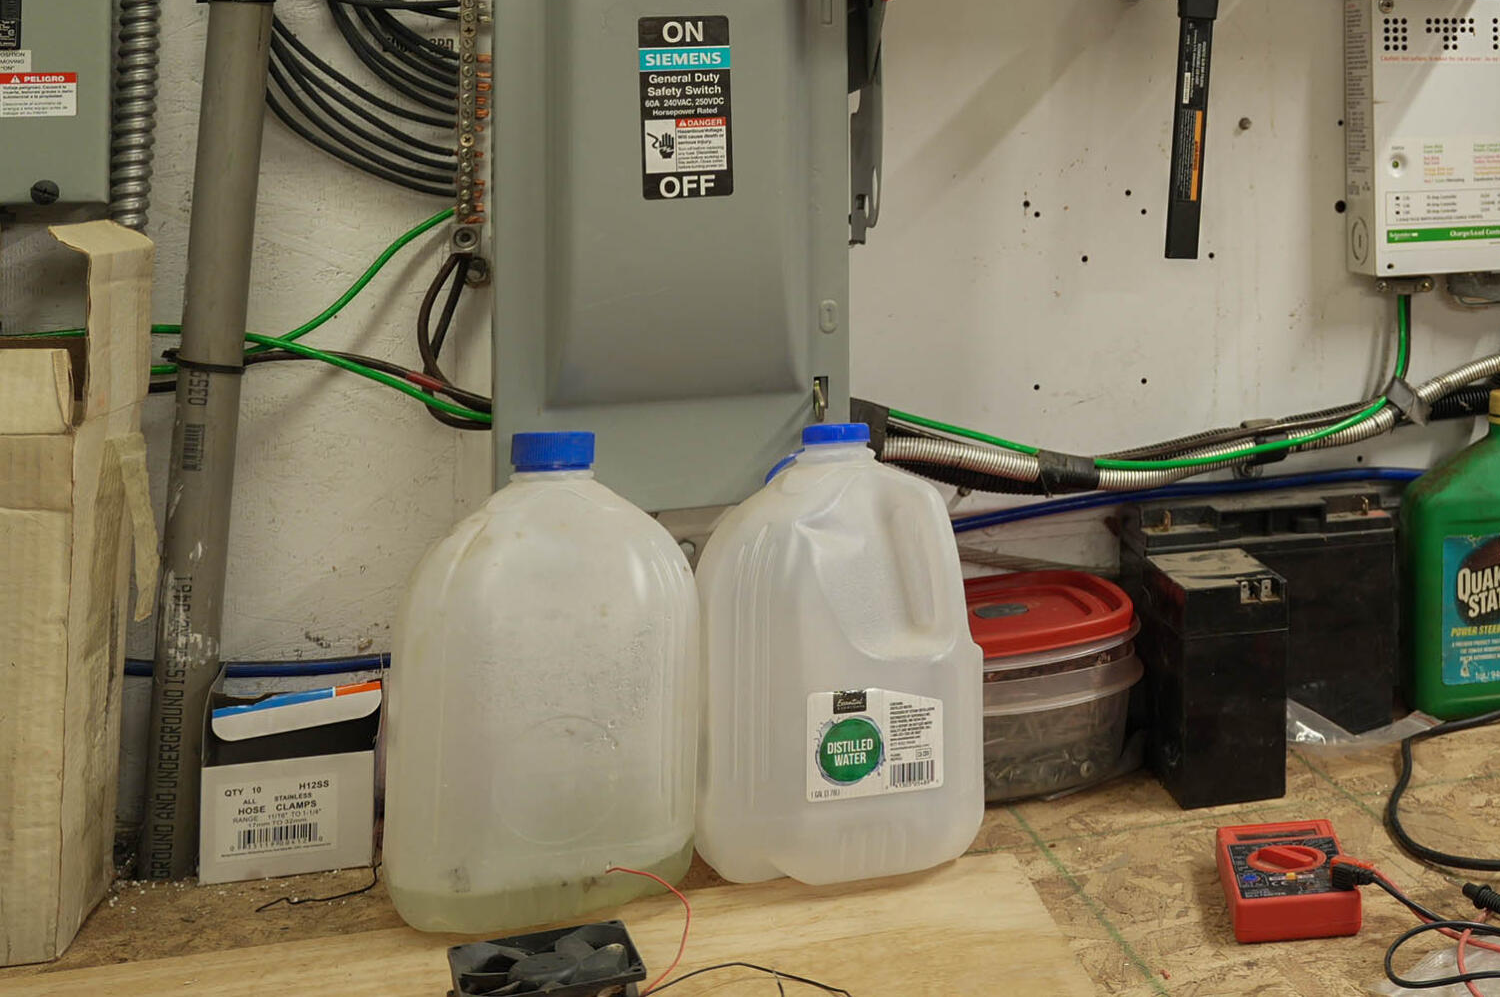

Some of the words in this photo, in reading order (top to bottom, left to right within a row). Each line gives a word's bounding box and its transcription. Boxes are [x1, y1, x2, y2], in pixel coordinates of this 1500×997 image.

[662, 21, 703, 43] ON
[645, 52, 722, 66] SIEMENS
[649, 73, 691, 84] General
[694, 72, 720, 83] Duty
[647, 86, 681, 97] Safety
[685, 85, 721, 95] Switch
[694, 97, 724, 105] 250VDC
[653, 108, 695, 117] Horsepower
[1451, 626, 1477, 637] POWER
[158, 689, 184, 788] UNDERGROUND
[827, 738, 874, 755] DISTILLED
[834, 752, 867, 766] WATER
[225, 788, 244, 797] QTY
[299, 780, 329, 790] H12SS
[274, 792, 312, 801] STAINLESS
[157, 791, 178, 822] AND
[238, 806, 265, 815] HOSE
[276, 800, 316, 811] CLAMPS
